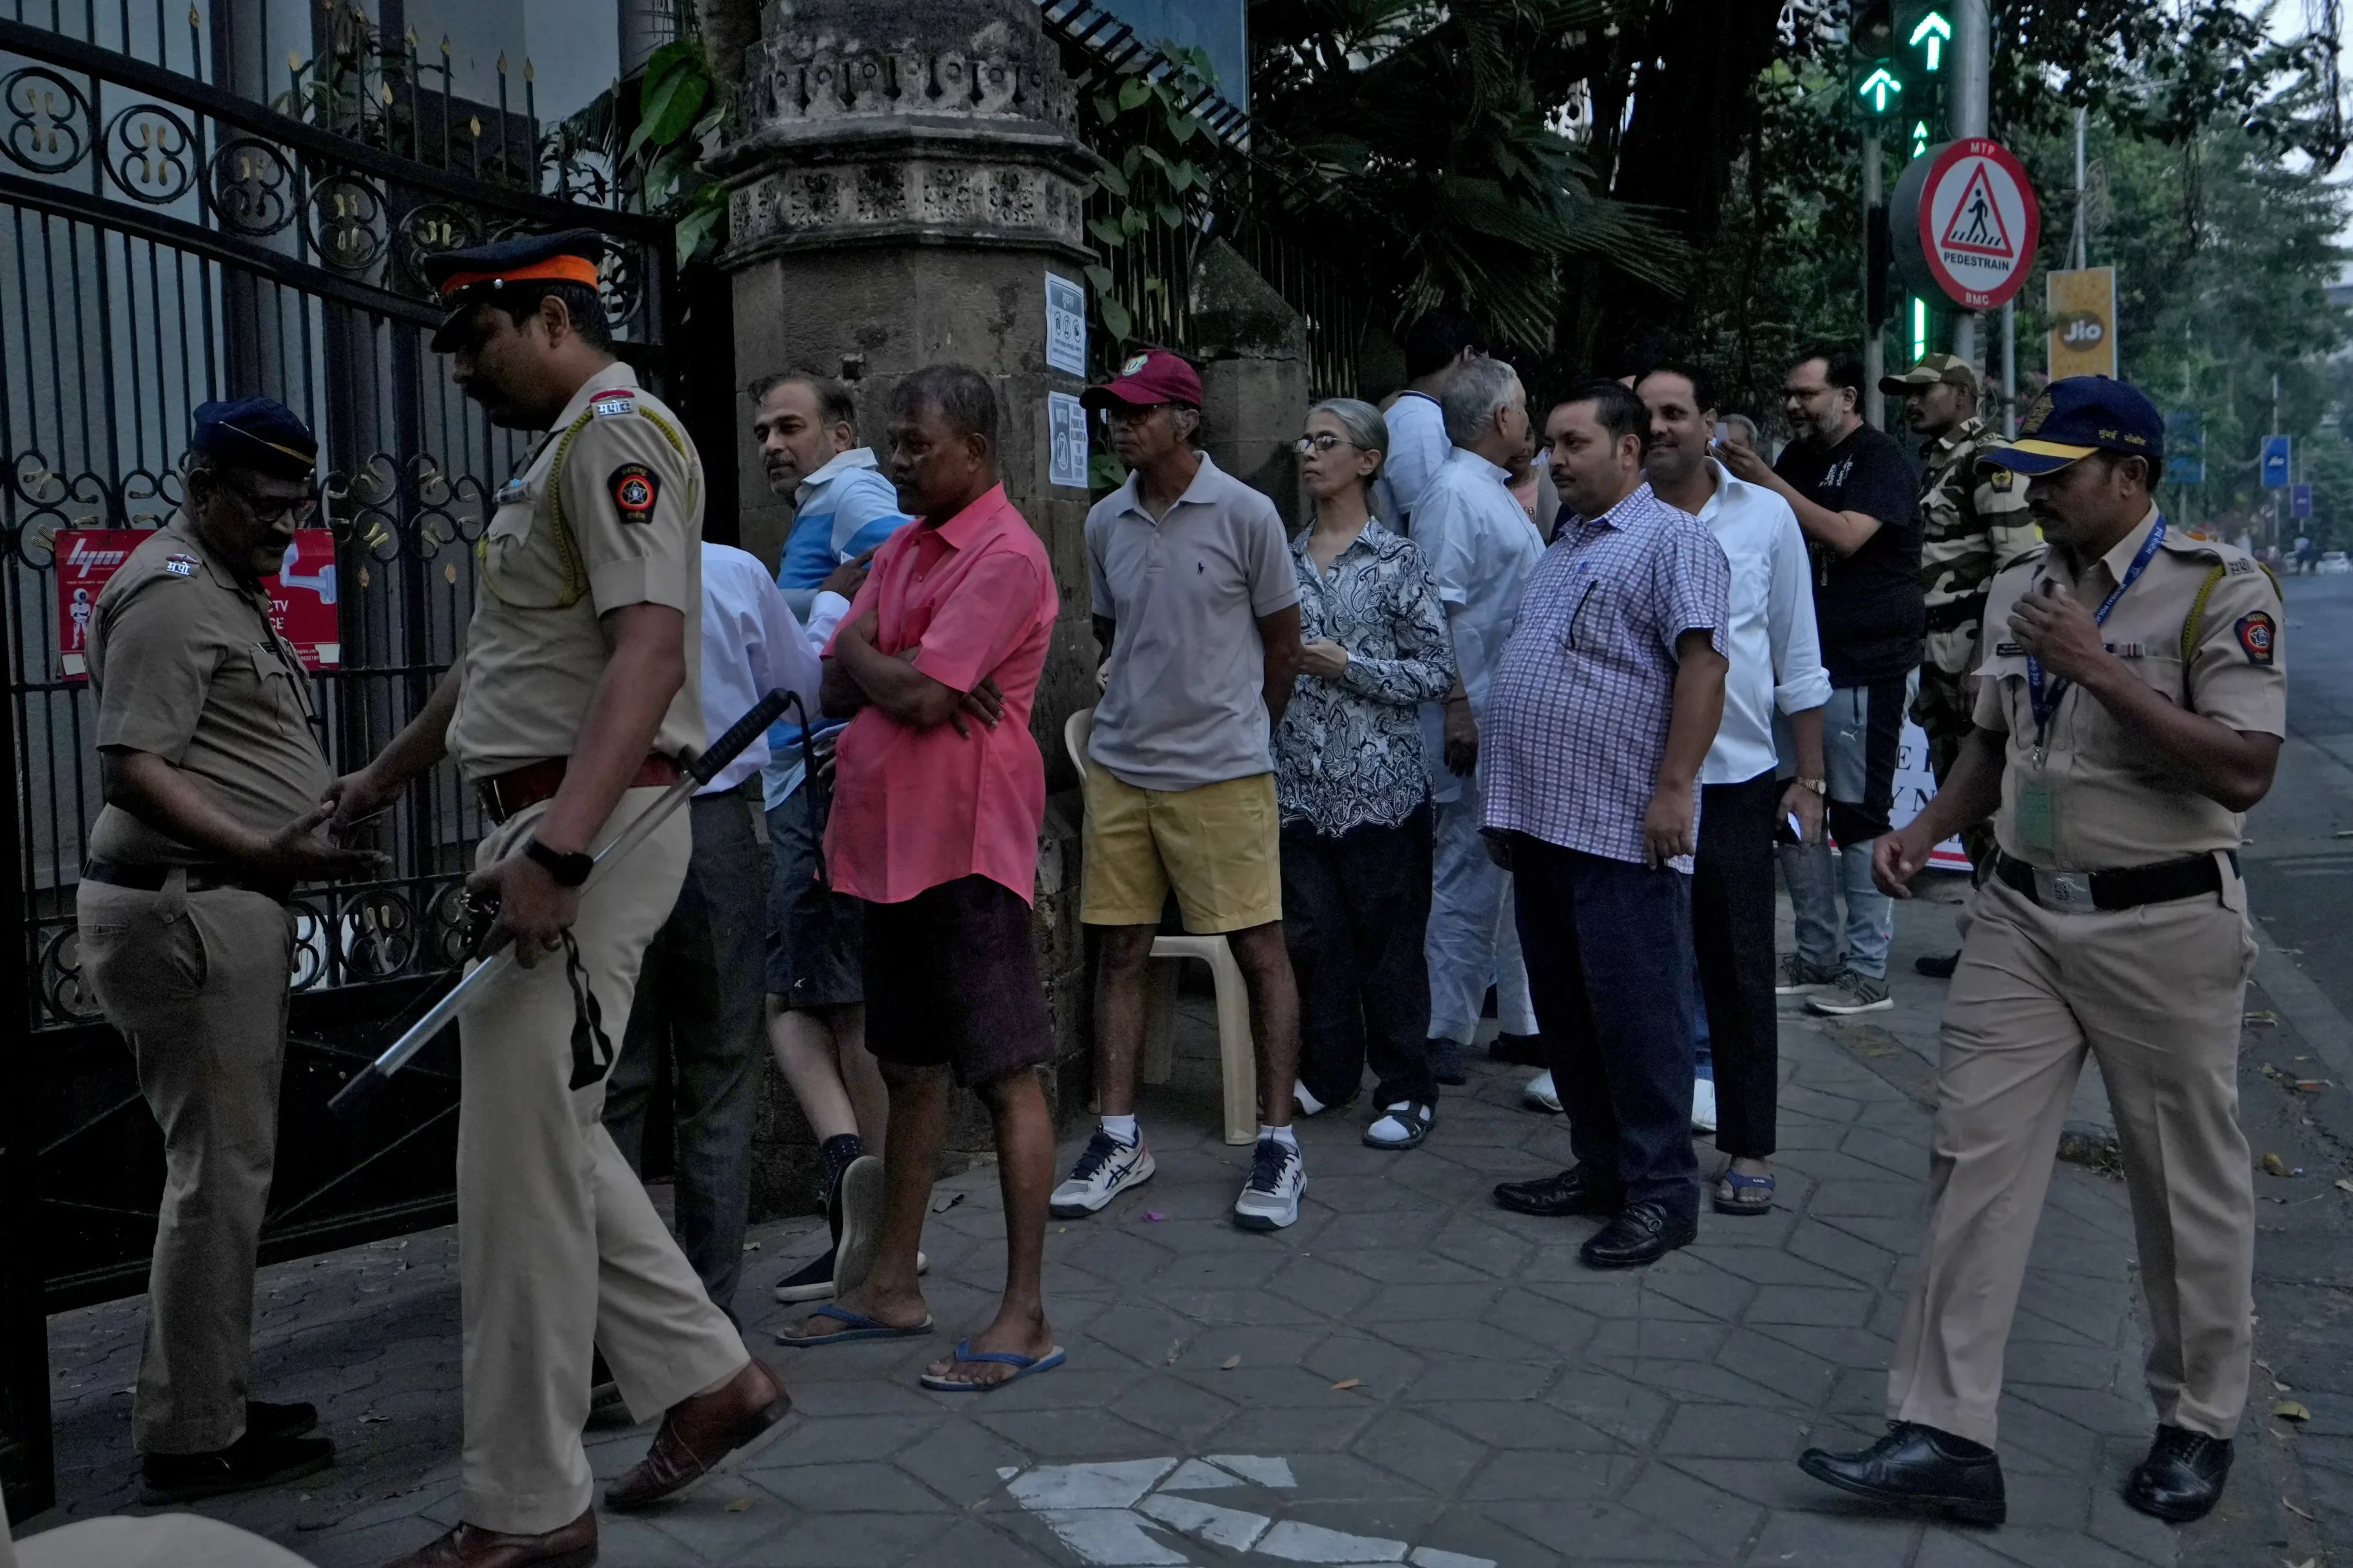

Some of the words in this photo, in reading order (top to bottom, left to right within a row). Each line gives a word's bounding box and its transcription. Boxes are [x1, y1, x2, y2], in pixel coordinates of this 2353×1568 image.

[1971, 141, 1995, 156] MTP
[1944, 251, 2009, 272] PEDESTRAIN
[1965, 292, 1989, 305] BMC
[2063, 319, 2102, 341] Jio
[2106, 583, 2126, 605] MUMBAI
